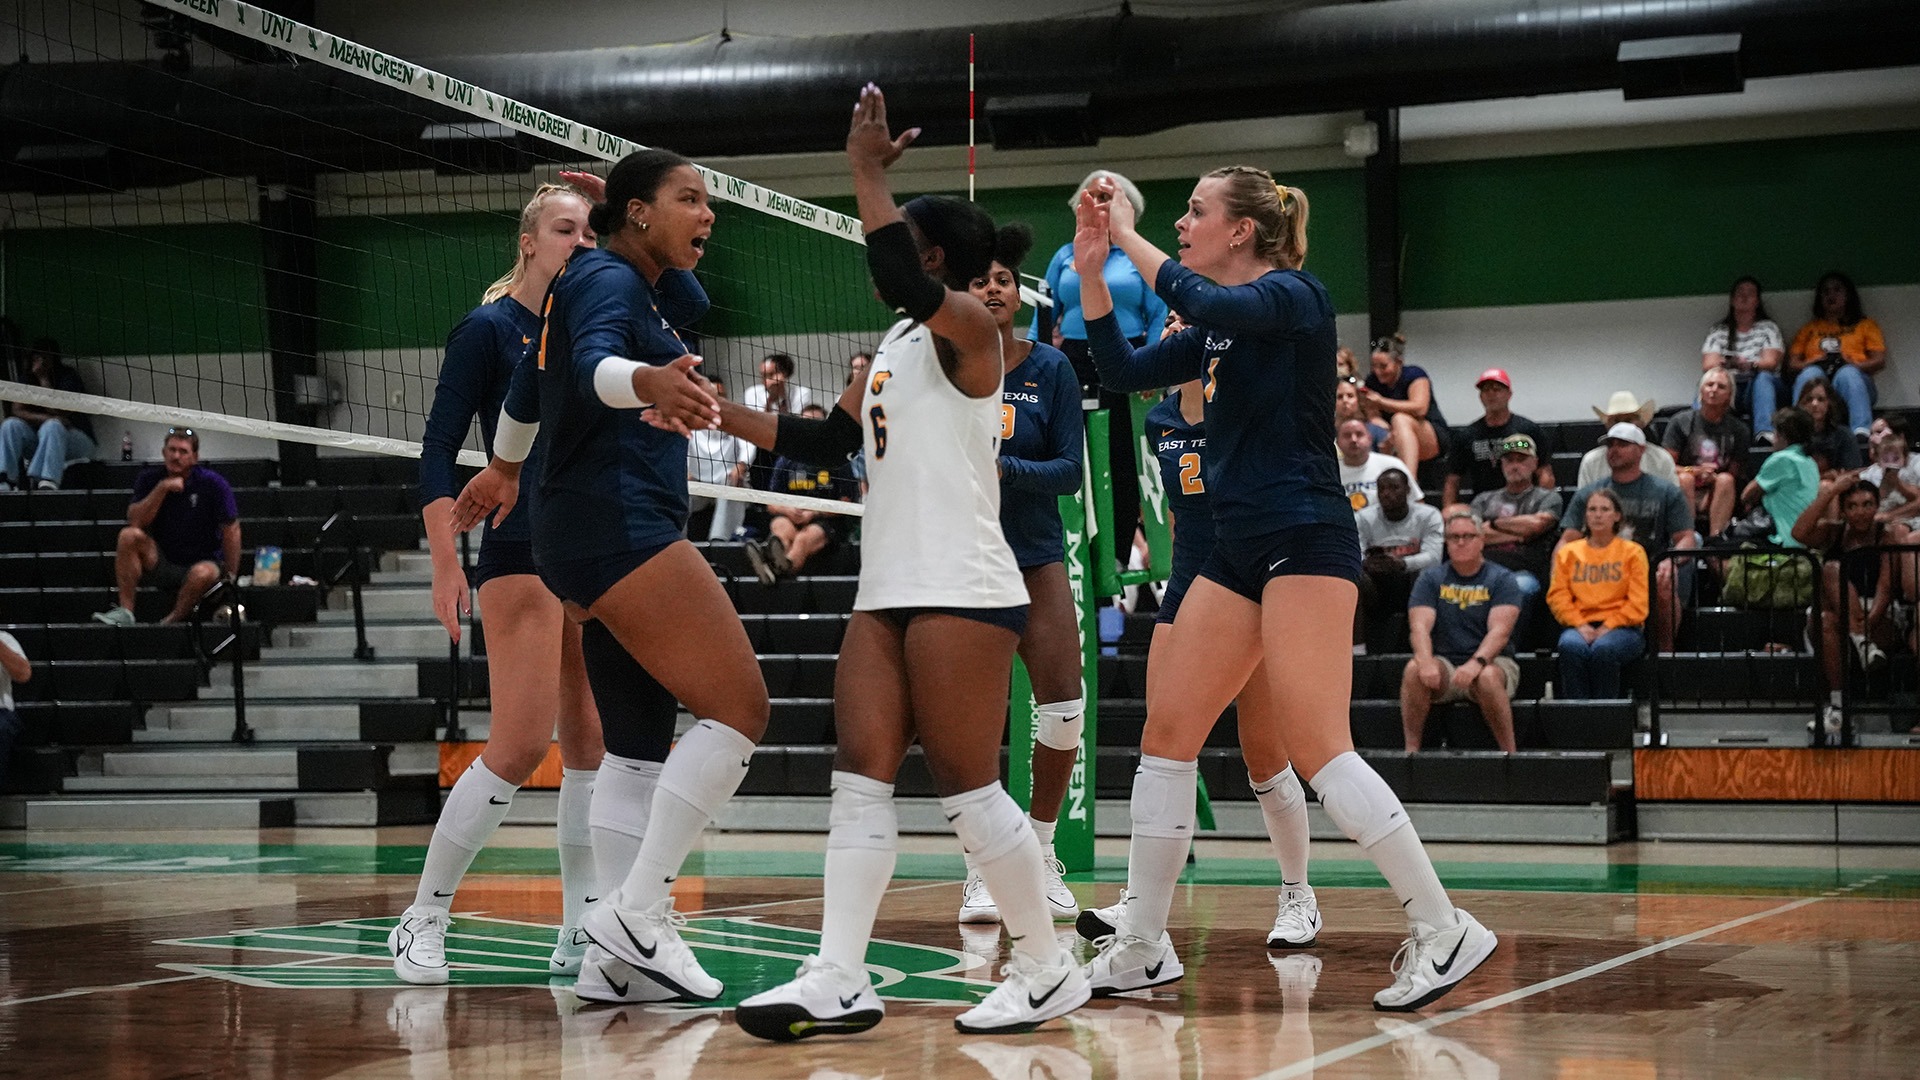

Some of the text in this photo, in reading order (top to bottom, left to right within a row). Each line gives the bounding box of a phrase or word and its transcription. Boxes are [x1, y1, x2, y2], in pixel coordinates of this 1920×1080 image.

[261, 11, 296, 43] UNT
[444, 77, 475, 106] UNT
[596, 131, 624, 157] UNT
[726, 176, 747, 199] UNT
[835, 213, 855, 235] UNT
[1002, 392, 1039, 403] EXAS
[870, 403, 887, 460] 6
[1158, 440, 1187, 452] EAST
[1178, 452, 1206, 495] 2
[1573, 560, 1622, 584] LIONS
